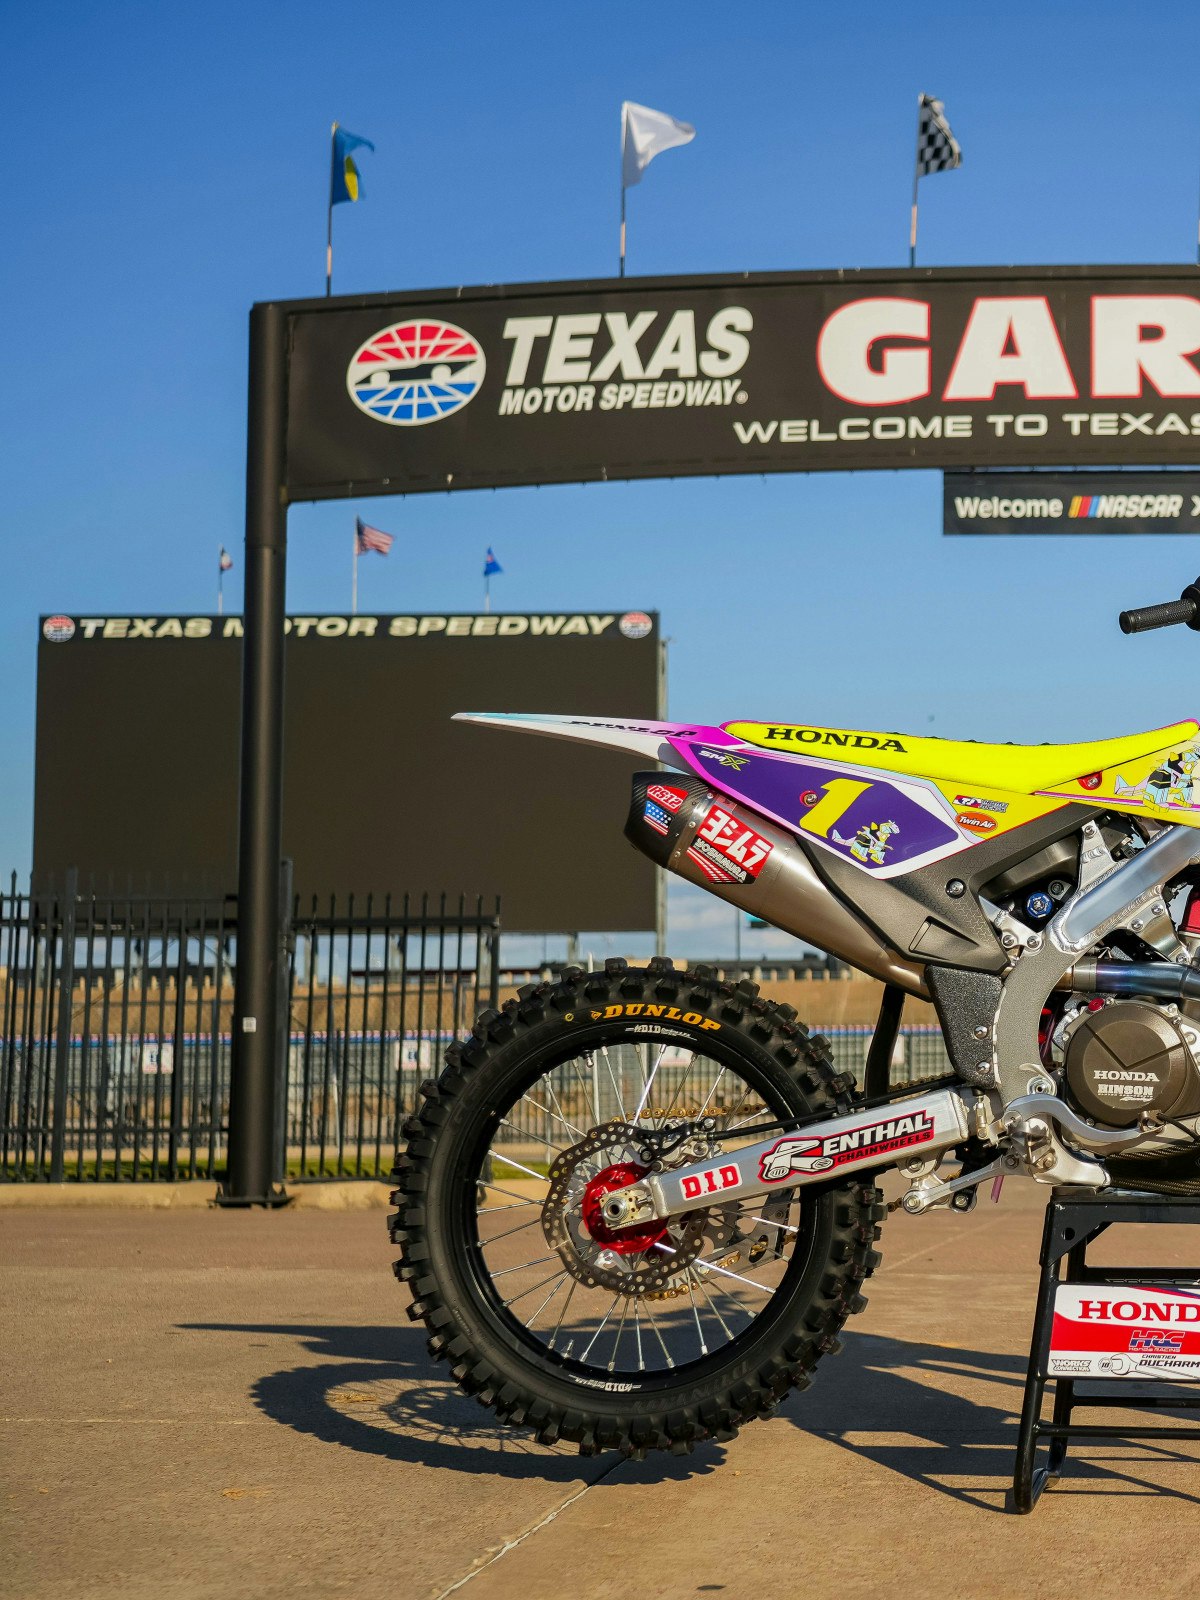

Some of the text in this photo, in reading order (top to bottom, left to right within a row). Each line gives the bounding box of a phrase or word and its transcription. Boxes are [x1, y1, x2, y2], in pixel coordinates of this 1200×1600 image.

[502, 306, 754, 386] TEXAS
[499, 385, 596, 416] MOTOR
[734, 415, 972, 443] WELCOME
[987, 414, 1048, 437] TO
[954, 496, 1063, 518] Welcome
[1097, 495, 1183, 518] NASCAR
[80, 615, 615, 638] TEXAS MTOR SPEEDWAY
[764, 727, 908, 753] HONDA
[800, 778, 874, 839] 1
[959, 815, 995, 829] Twin Air
[700, 810, 772, 868] ヨシムラ
[693, 838, 748, 881] YOSHIMURA
[603, 1003, 722, 1031] DUNLOP
[1093, 1070, 1160, 1083] HONDA
[1098, 1083, 1154, 1096] HINSON
[837, 1131, 931, 1163] CHAINWHEELS
[682, 1166, 740, 1199] D.I.D
[1129, 1329, 1186, 1349] HRC
[1052, 1358, 1092, 1367] WORKS
